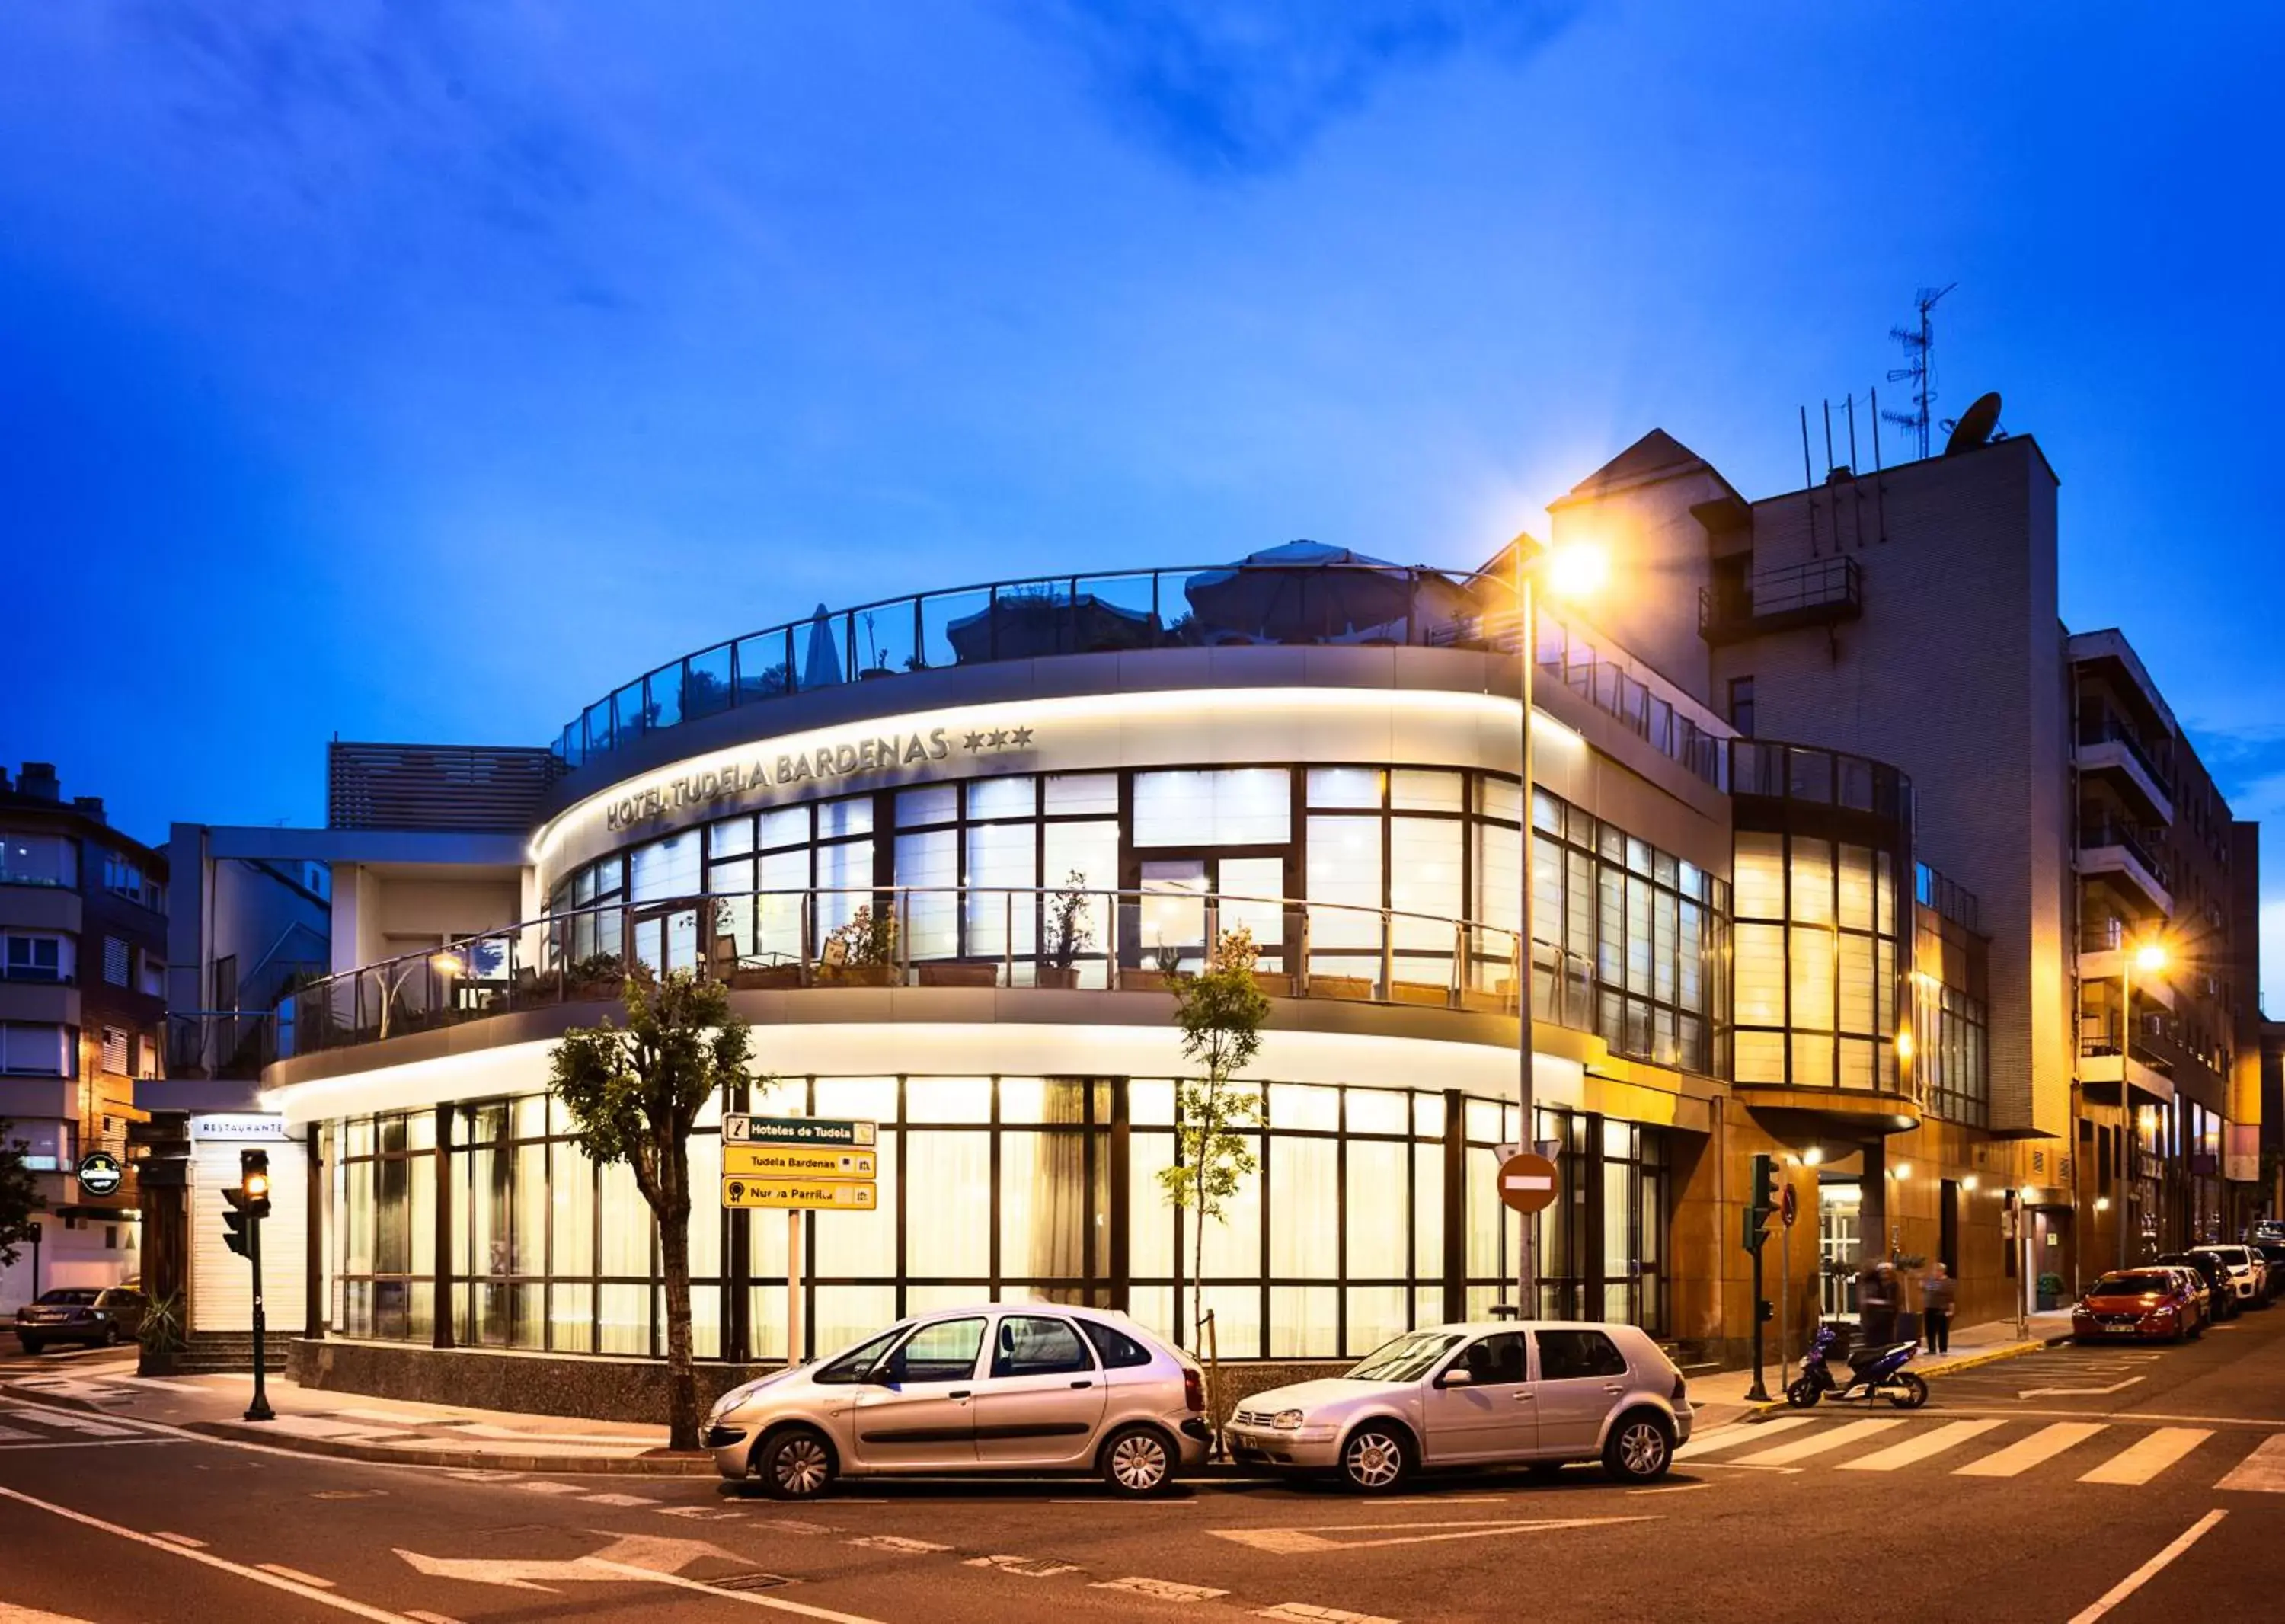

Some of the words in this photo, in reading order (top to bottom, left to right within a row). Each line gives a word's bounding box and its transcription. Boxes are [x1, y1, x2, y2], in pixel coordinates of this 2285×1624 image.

[607, 784, 670, 831] HOTEL
[670, 759, 770, 807] TUDELA
[776, 727, 950, 784] BARDENAS
[751, 1124, 794, 1136] Hoteles
[797, 1127, 812, 1136] de
[814, 1127, 851, 1138] Tudela
[751, 1156, 785, 1167] Tudela
[788, 1157, 836, 1168] Bardenas
